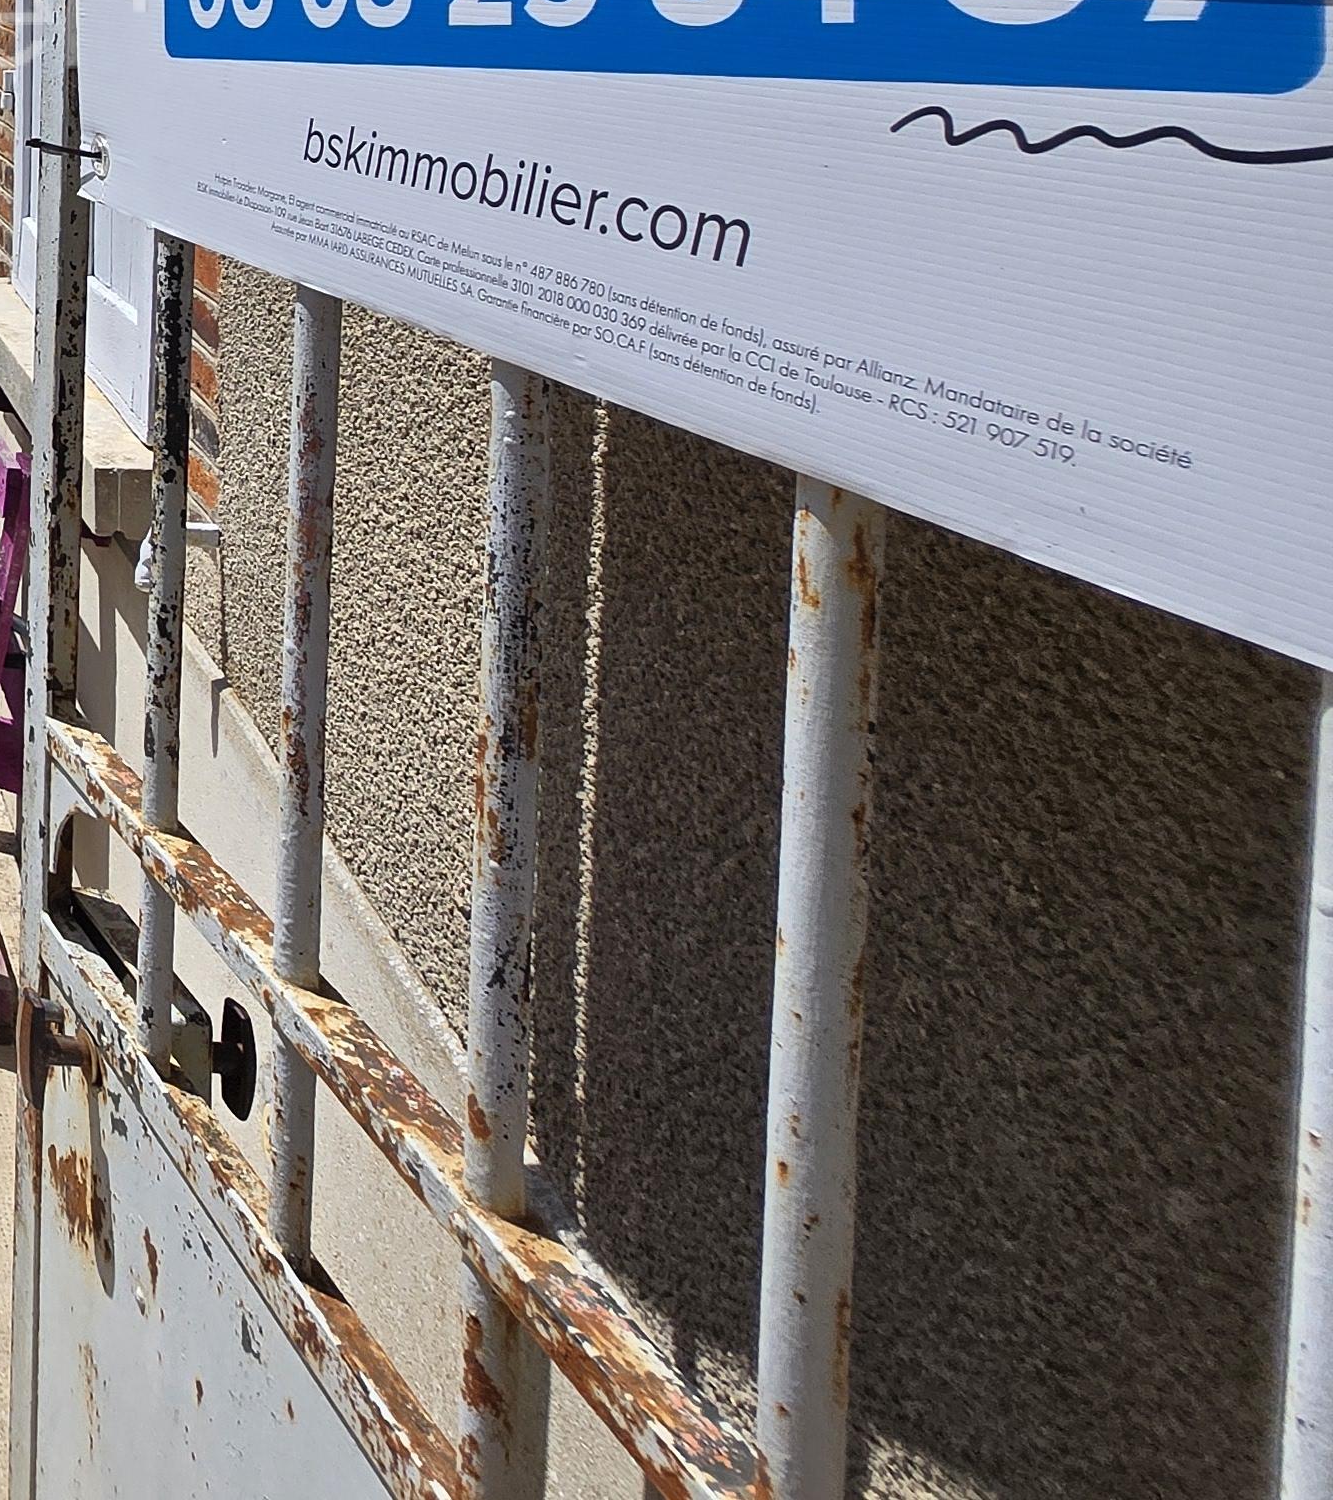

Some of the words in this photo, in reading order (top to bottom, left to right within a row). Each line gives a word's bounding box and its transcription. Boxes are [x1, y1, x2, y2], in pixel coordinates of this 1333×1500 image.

[303, 117, 751, 268] bskimmobilier.com
[349, 247, 405, 275] ASSURANCES
[406, 264, 458, 292] MUTUELLES
[477, 288, 519, 312] Garantie
[521, 301, 570, 330] financière
[572, 322, 592, 336] par
[648, 342, 680, 366] (sans
[683, 354, 744, 388] détention
[747, 376, 767, 395] de
[411, 230, 436, 247] RSAC
[437, 237, 449, 250] de
[451, 241, 480, 260] Melun
[481, 254, 502, 268] sous
[504, 255, 513, 270] le
[530, 265, 553, 281] 487
[555, 271, 578, 289] 886
[581, 278, 605, 297] 780
[608, 286, 637, 307] (sans
[640, 296, 696, 325] détention
[700, 313, 718, 331] de
[772, 337, 819, 361] assuré
[824, 352, 853, 370] par
[923, 377, 1040, 426] Mandataire
[1047, 412, 1075, 435] de
[1081, 420, 1101, 444] la
[1108, 435, 1193, 469] société
[417, 250, 441, 268] Carte
[442, 261, 508, 289] professionnelle
[511, 278, 534, 297] 3101
[538, 287, 564, 306] 2018
[566, 296, 590, 314] 000
[593, 304, 618, 323] 030
[620, 312, 646, 332] 369
[649, 321, 698, 348] délivrée
[701, 341, 725, 357] par
[728, 343, 741, 362] la
[745, 350, 775, 373] CCI
[779, 364, 800, 380] de
[804, 367, 872, 403] Toulouse
[888, 393, 929, 421] RCS
[942, 410, 977, 436] 521
[986, 422, 1030, 449] 907
